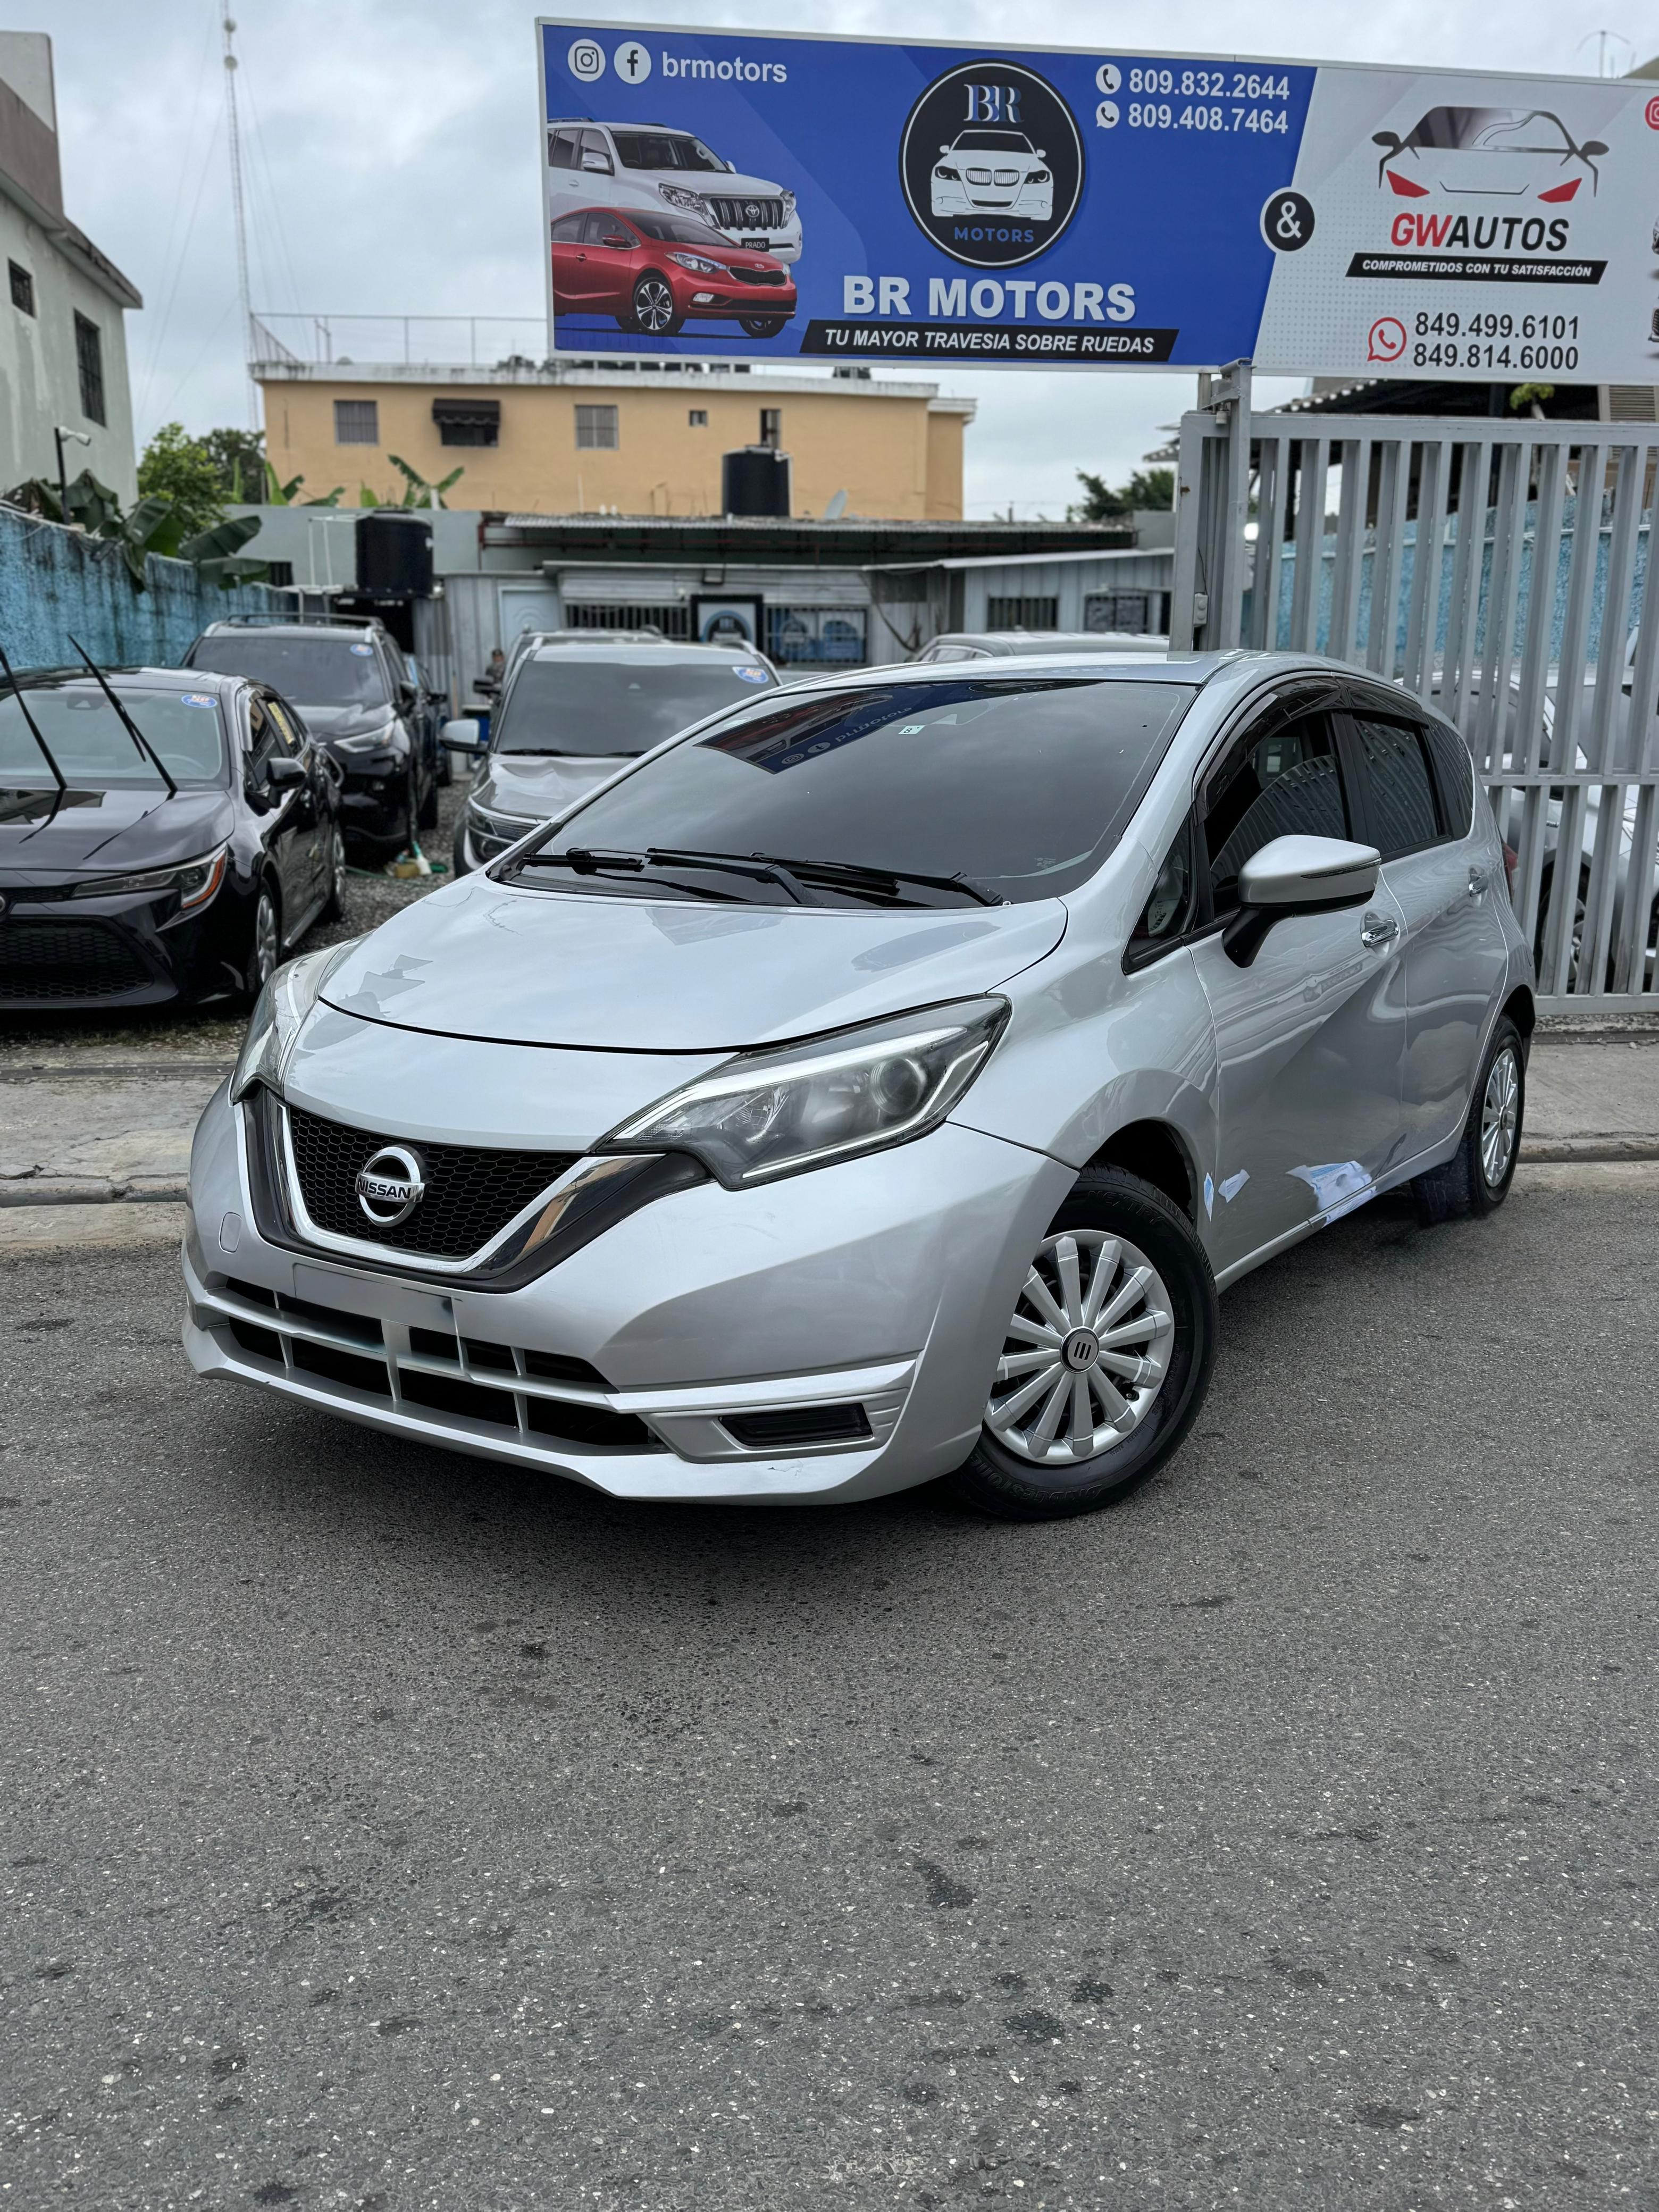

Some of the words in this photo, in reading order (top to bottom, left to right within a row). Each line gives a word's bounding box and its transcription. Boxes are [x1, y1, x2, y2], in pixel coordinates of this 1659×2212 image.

[662, 52, 787, 82] brmotors
[1129, 68, 1290, 100] 809.832.2644
[963, 83, 1026, 123] BR
[1128, 103, 1288, 134] 809.408.7464
[954, 227, 1034, 242] MOTORS
[1390, 212, 1569, 252] GWAUTOS
[1362, 259, 1463, 273] COMPROMETIDOS
[1465, 263, 1490, 274] CON
[1494, 264, 1509, 274] TU
[1512, 263, 1592, 277] SATISFACCIÓN
[843, 275, 910, 315] BR
[929, 278, 1136, 322] MOTORS
[1415, 312, 1579, 339] 849.499.6101
[825, 329, 849, 346] TU
[853, 330, 918, 348] MAYOR
[924, 332, 1010, 350] TRAVESIA
[1015, 334, 1078, 351] SOBRE
[1081, 336, 1154, 354] RUEDAS
[1413, 343, 1579, 370] 849.814.6000
[358, 1178, 412, 1199] NISSAN
